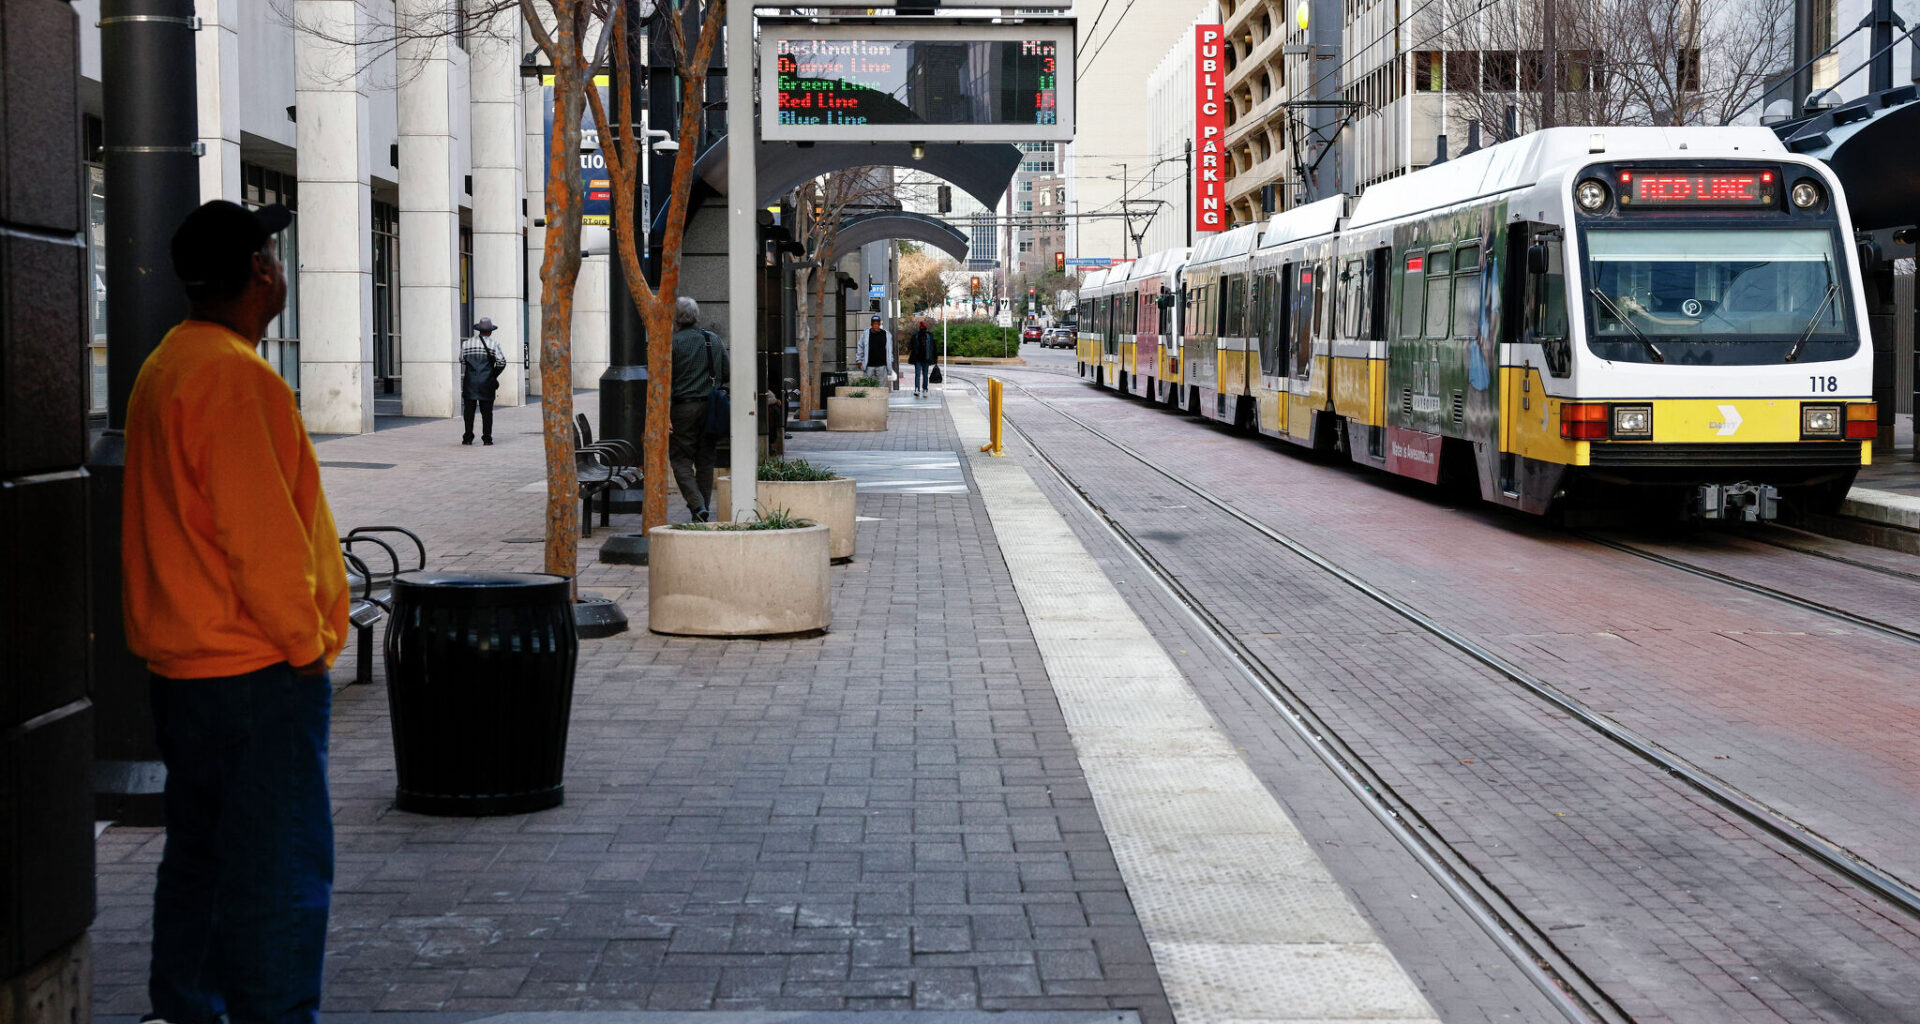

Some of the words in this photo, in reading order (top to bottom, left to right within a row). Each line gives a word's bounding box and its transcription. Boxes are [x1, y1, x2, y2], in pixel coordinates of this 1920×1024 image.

[777, 39, 891, 55] Destination
[1022, 39, 1055, 55] Min
[777, 57, 844, 73] Orange
[850, 57, 891, 73] Line
[1042, 57, 1055, 72] 3
[1202, 30, 1218, 115] PUBLIC
[778, 75, 835, 91] Green
[840, 75, 881, 91] Line
[1039, 75, 1055, 90] 11
[778, 92, 812, 108] Red
[817, 92, 859, 108] Line
[1035, 92, 1055, 108] 15
[778, 110, 820, 125] Blue
[827, 110, 867, 125] Line
[580, 155, 608, 169] tio
[1202, 126, 1218, 225] PARKING
[1640, 177, 1691, 199] RED
[1697, 177, 1753, 199] LINE
[583, 217, 608, 226] RT.org
[1809, 375, 1838, 393] 118
